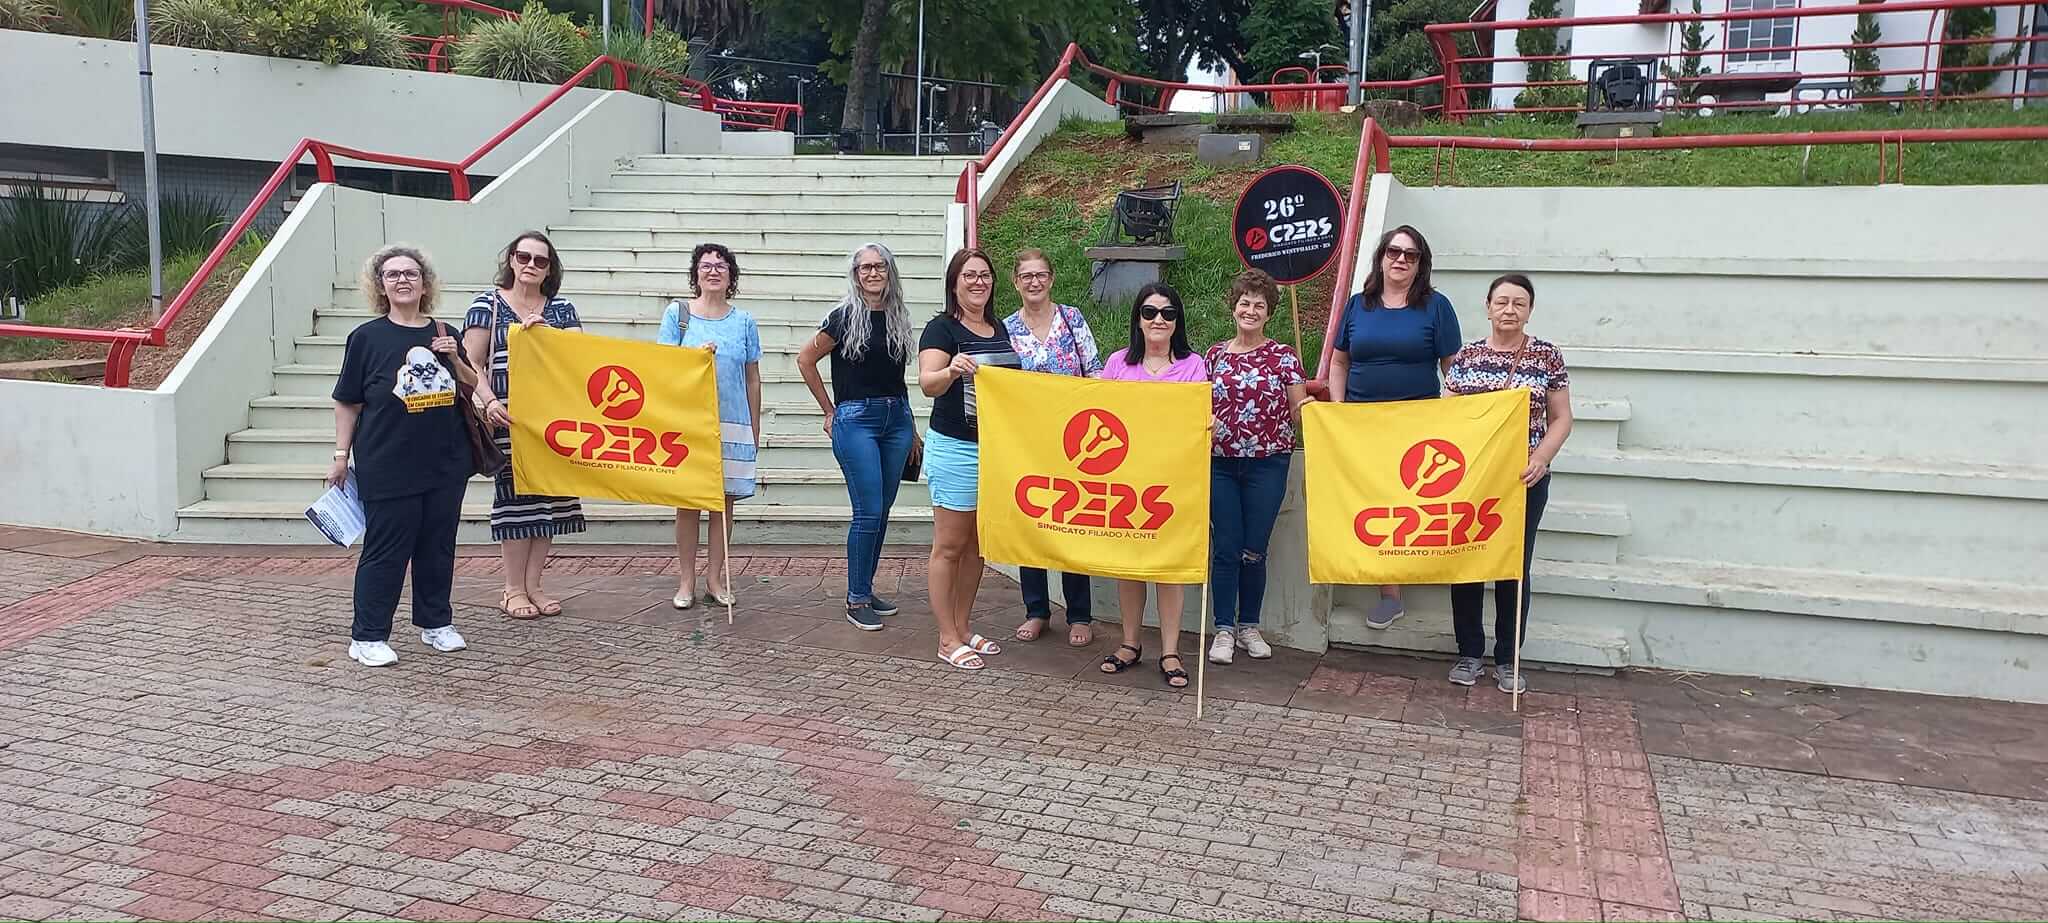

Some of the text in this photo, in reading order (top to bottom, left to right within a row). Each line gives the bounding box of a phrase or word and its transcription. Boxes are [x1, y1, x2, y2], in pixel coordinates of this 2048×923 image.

[1269, 217, 1332, 243] CPERS
[544, 419, 689, 468] CPERS
[569, 459, 614, 469] SINDICATO
[615, 464, 648, 473] FILIADO
[655, 467, 676, 475] CNTE
[1015, 475, 1174, 530] CPERS
[1037, 522, 1086, 535] SINDICATO
[1088, 529, 1123, 538] FILIADO
[1354, 498, 1503, 546] CPERS
[1431, 546, 1461, 556] FILIADO
[1467, 544, 1487, 552] CNTE
